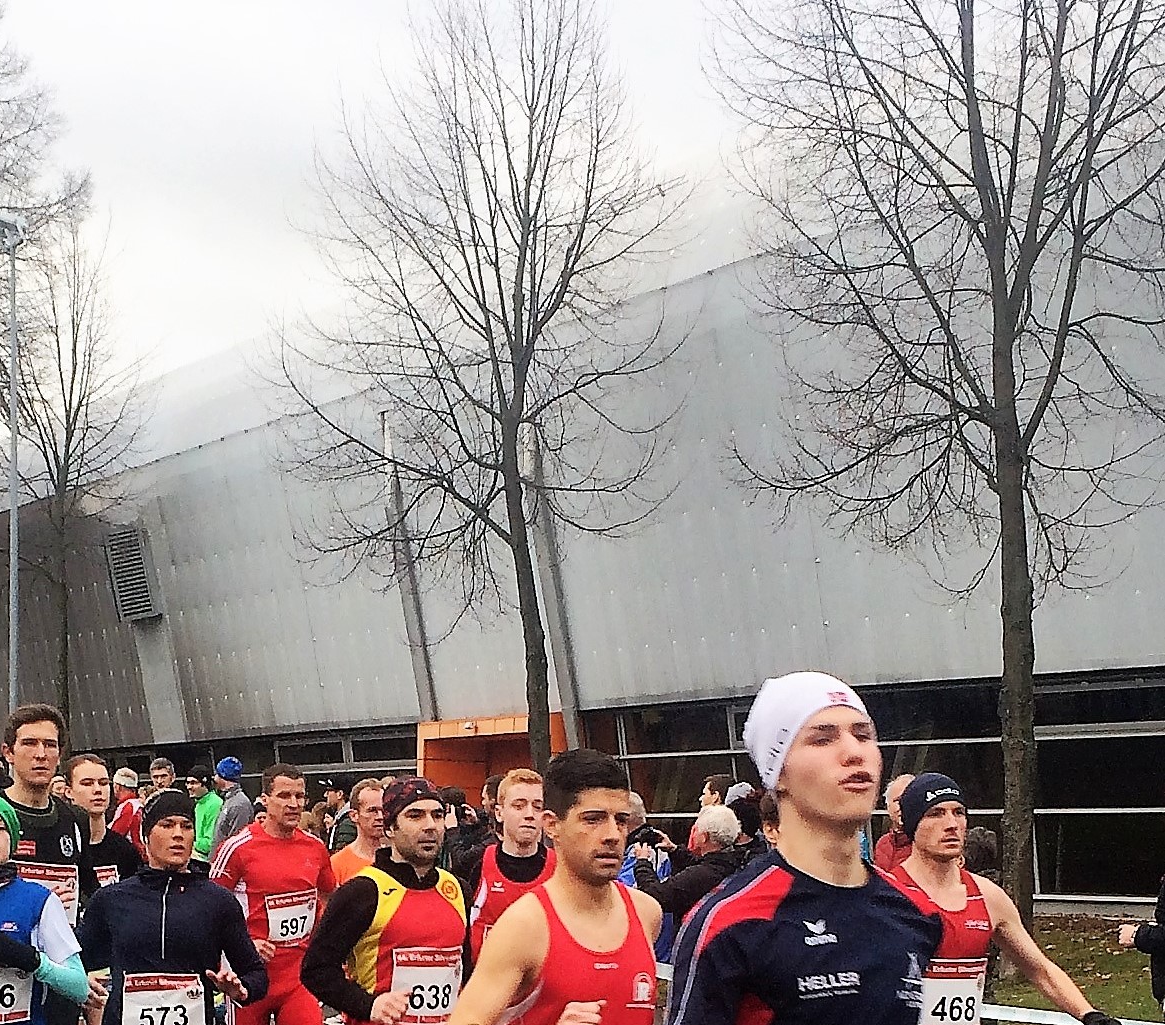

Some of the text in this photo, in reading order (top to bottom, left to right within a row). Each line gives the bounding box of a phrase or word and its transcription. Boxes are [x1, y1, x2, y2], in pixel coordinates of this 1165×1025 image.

[279, 915, 308, 937] 597
[797, 972, 861, 992] HELLER
[409, 984, 452, 1010] 638
[931, 996, 976, 1022] 468
